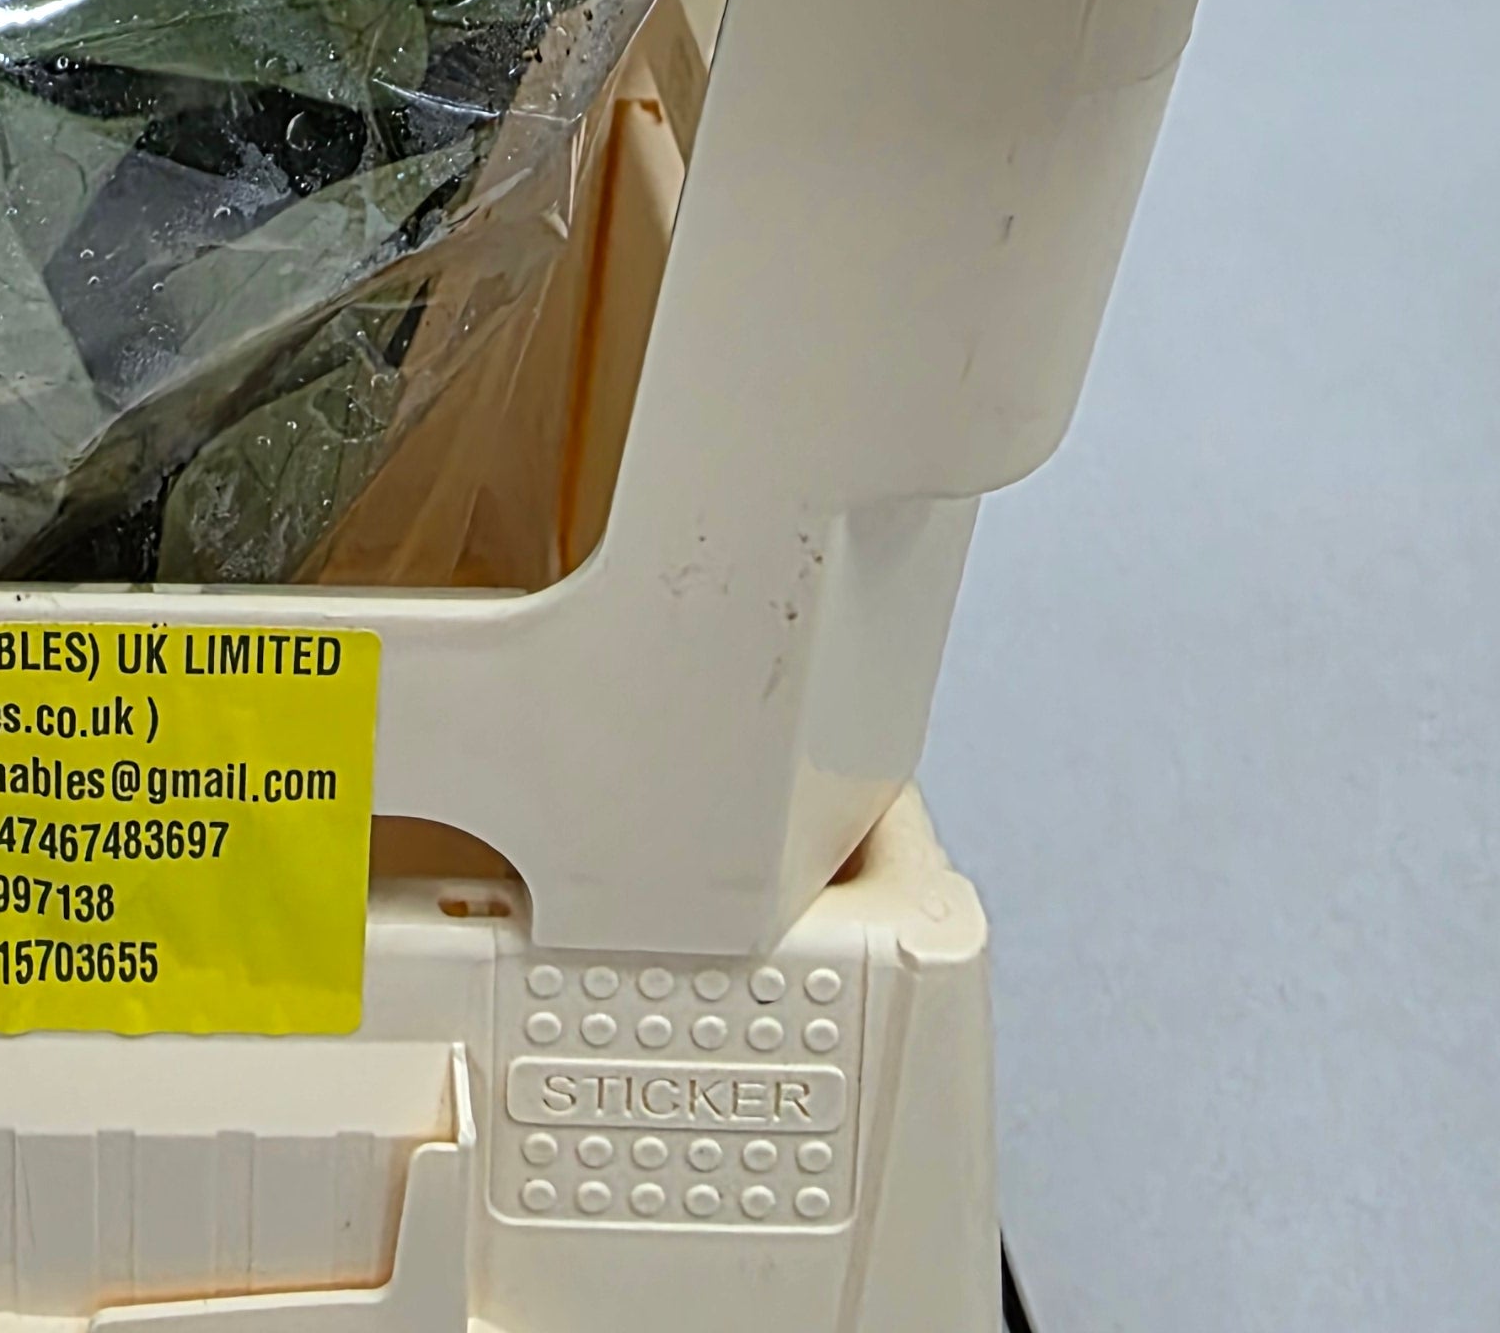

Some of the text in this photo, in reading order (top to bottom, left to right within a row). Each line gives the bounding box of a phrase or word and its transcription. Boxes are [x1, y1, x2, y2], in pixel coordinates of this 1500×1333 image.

[119, 634, 167, 674] UK
[186, 635, 340, 675] LIMITED
[542, 1073, 814, 1123] STICKER
